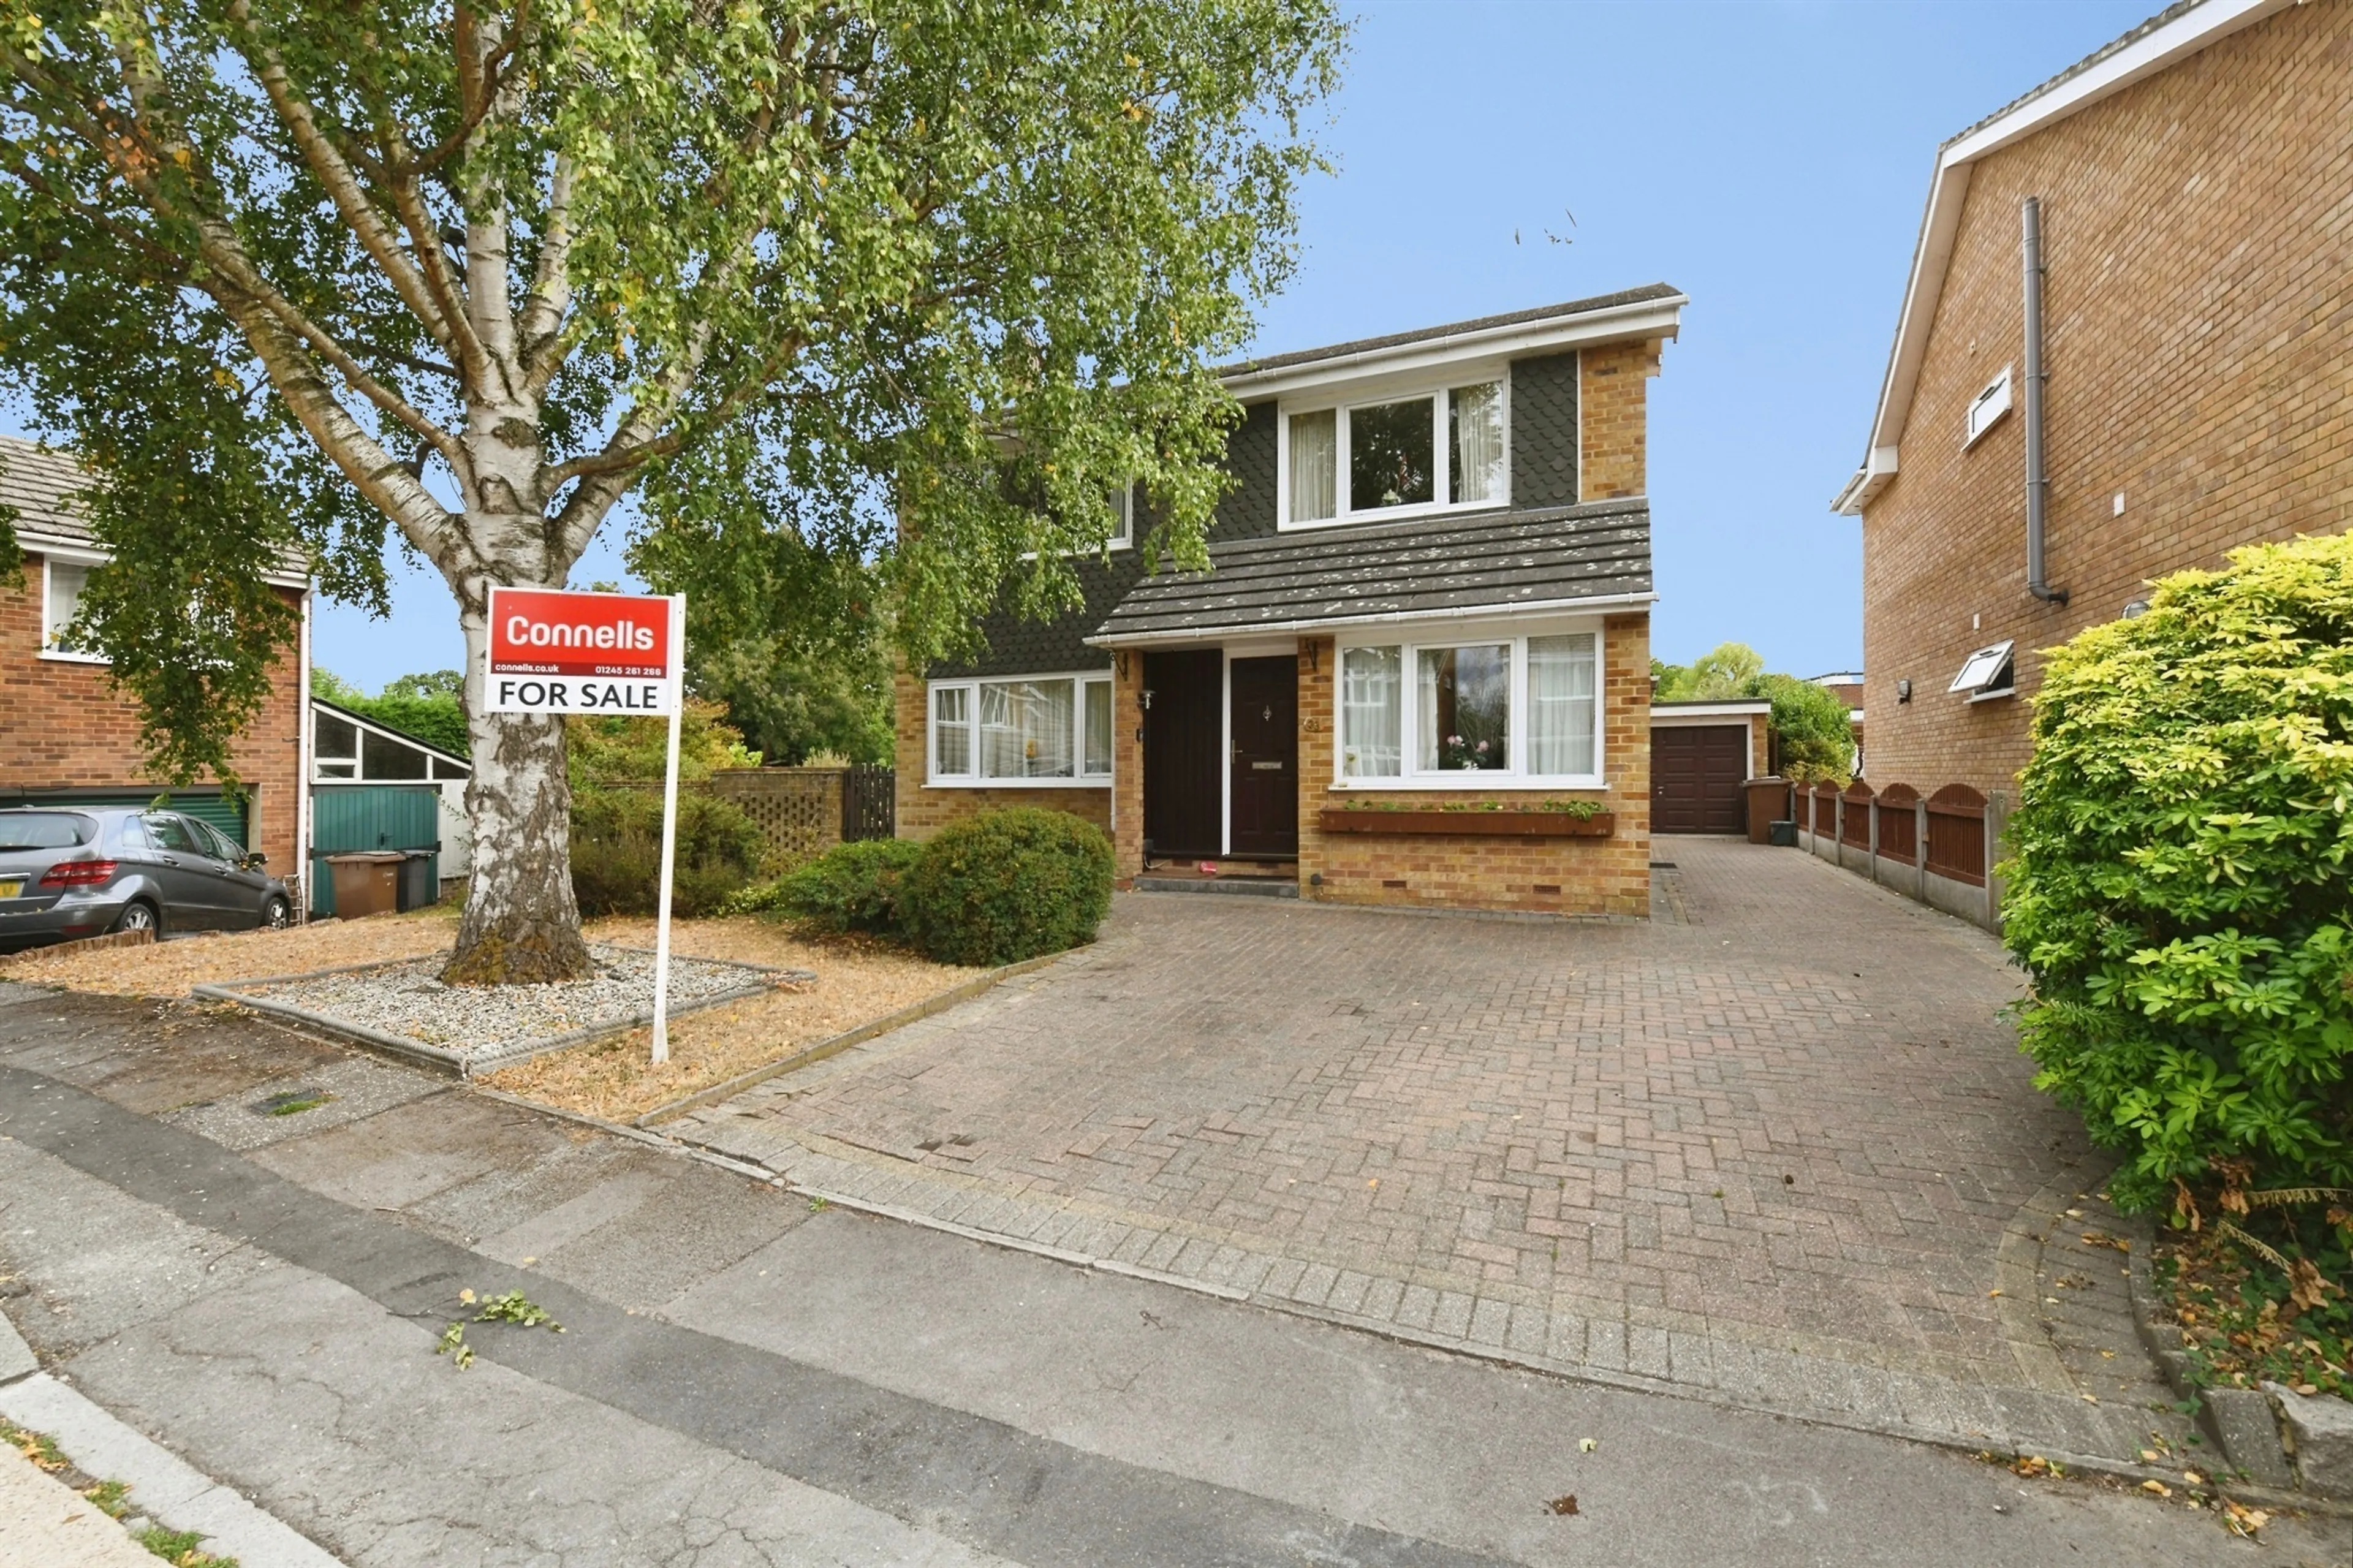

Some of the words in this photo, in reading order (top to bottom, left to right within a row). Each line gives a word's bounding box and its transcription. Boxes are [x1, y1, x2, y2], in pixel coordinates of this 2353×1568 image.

[507, 615, 654, 650] Connells
[495, 664, 559, 673] connells.co.uk
[595, 666, 623, 675] 01245
[499, 681, 569, 706] FOR
[580, 683, 657, 709] SALE
